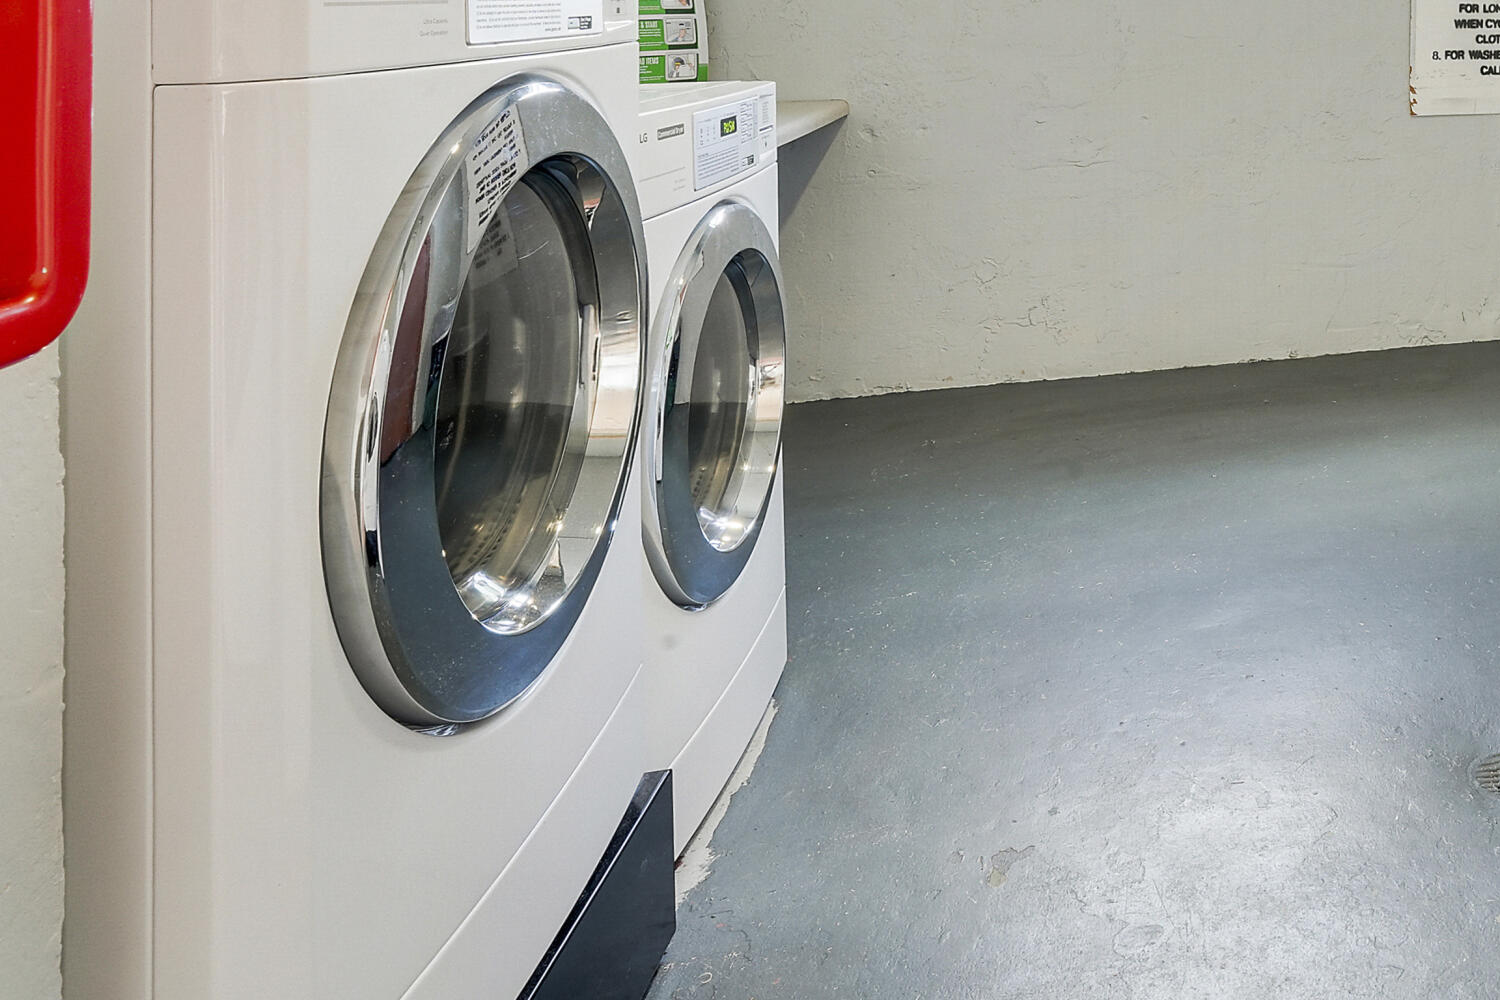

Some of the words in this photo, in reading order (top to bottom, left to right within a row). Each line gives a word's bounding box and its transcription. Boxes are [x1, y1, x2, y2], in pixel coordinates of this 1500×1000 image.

[1459, 4, 1479, 13] FOR
[1454, 19, 1483, 28] WHEN
[1432, 51, 1441, 60] 8.
[1445, 50, 1464, 59] FOR
[640, 133, 647, 143] LG
